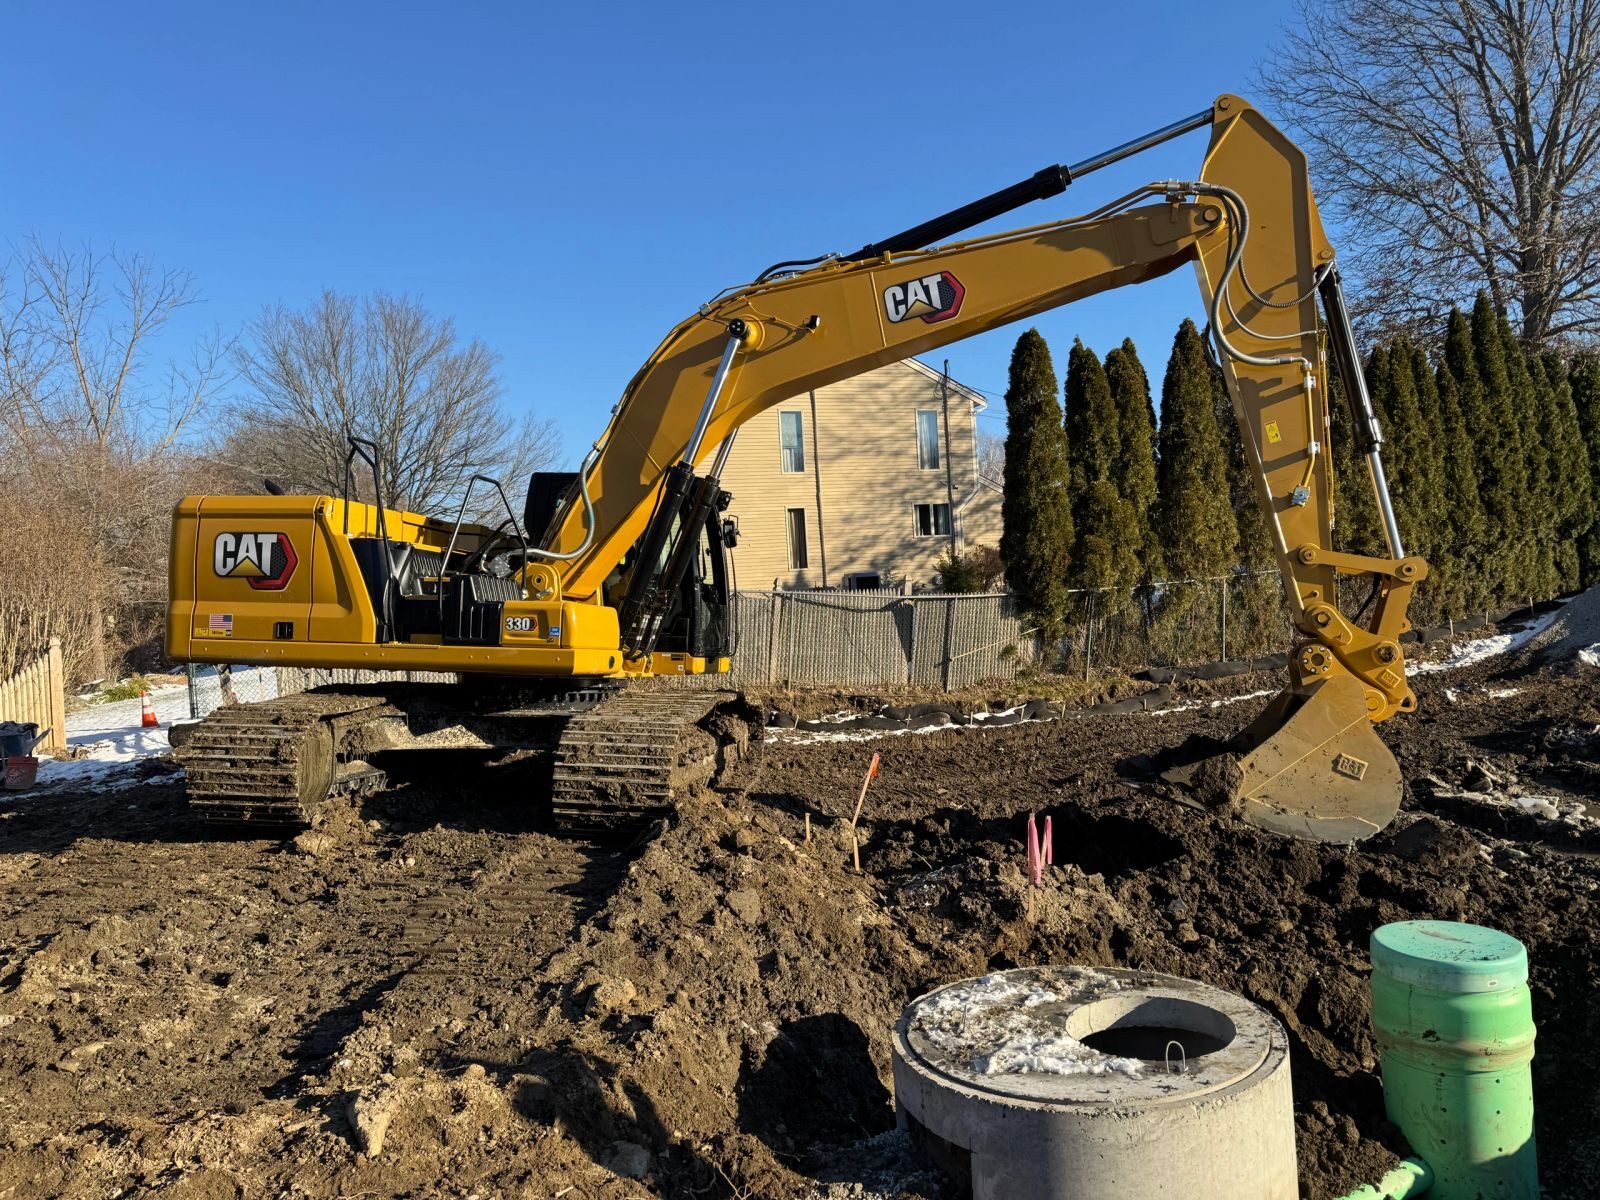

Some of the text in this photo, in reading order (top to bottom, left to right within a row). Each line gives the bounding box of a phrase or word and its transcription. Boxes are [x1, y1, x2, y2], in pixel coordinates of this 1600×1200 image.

[884, 273, 942, 322] CAT
[215, 532, 278, 576] CAT
[506, 616, 531, 631] 330
